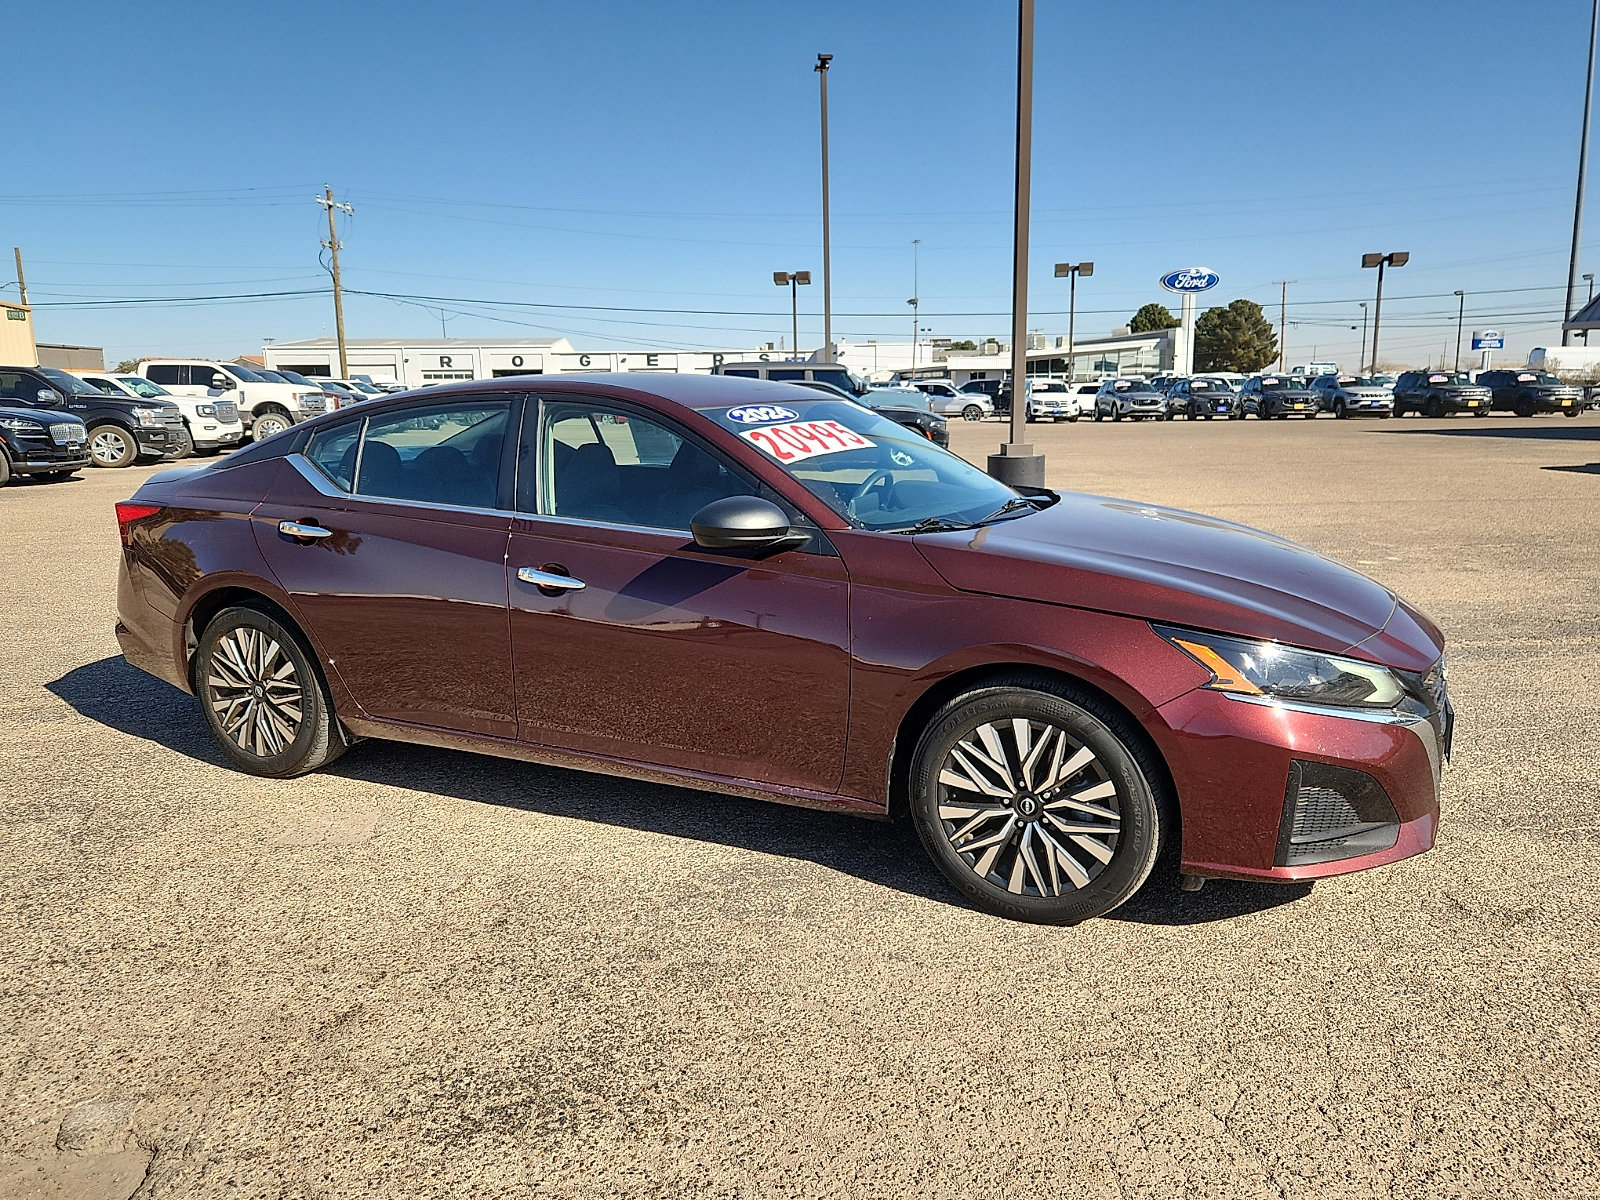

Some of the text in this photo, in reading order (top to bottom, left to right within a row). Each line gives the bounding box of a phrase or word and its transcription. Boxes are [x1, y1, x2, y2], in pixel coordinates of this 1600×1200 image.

[1174, 272, 1210, 289] Ford
[731, 405, 795, 424] 2024
[748, 421, 866, 462] 20995
